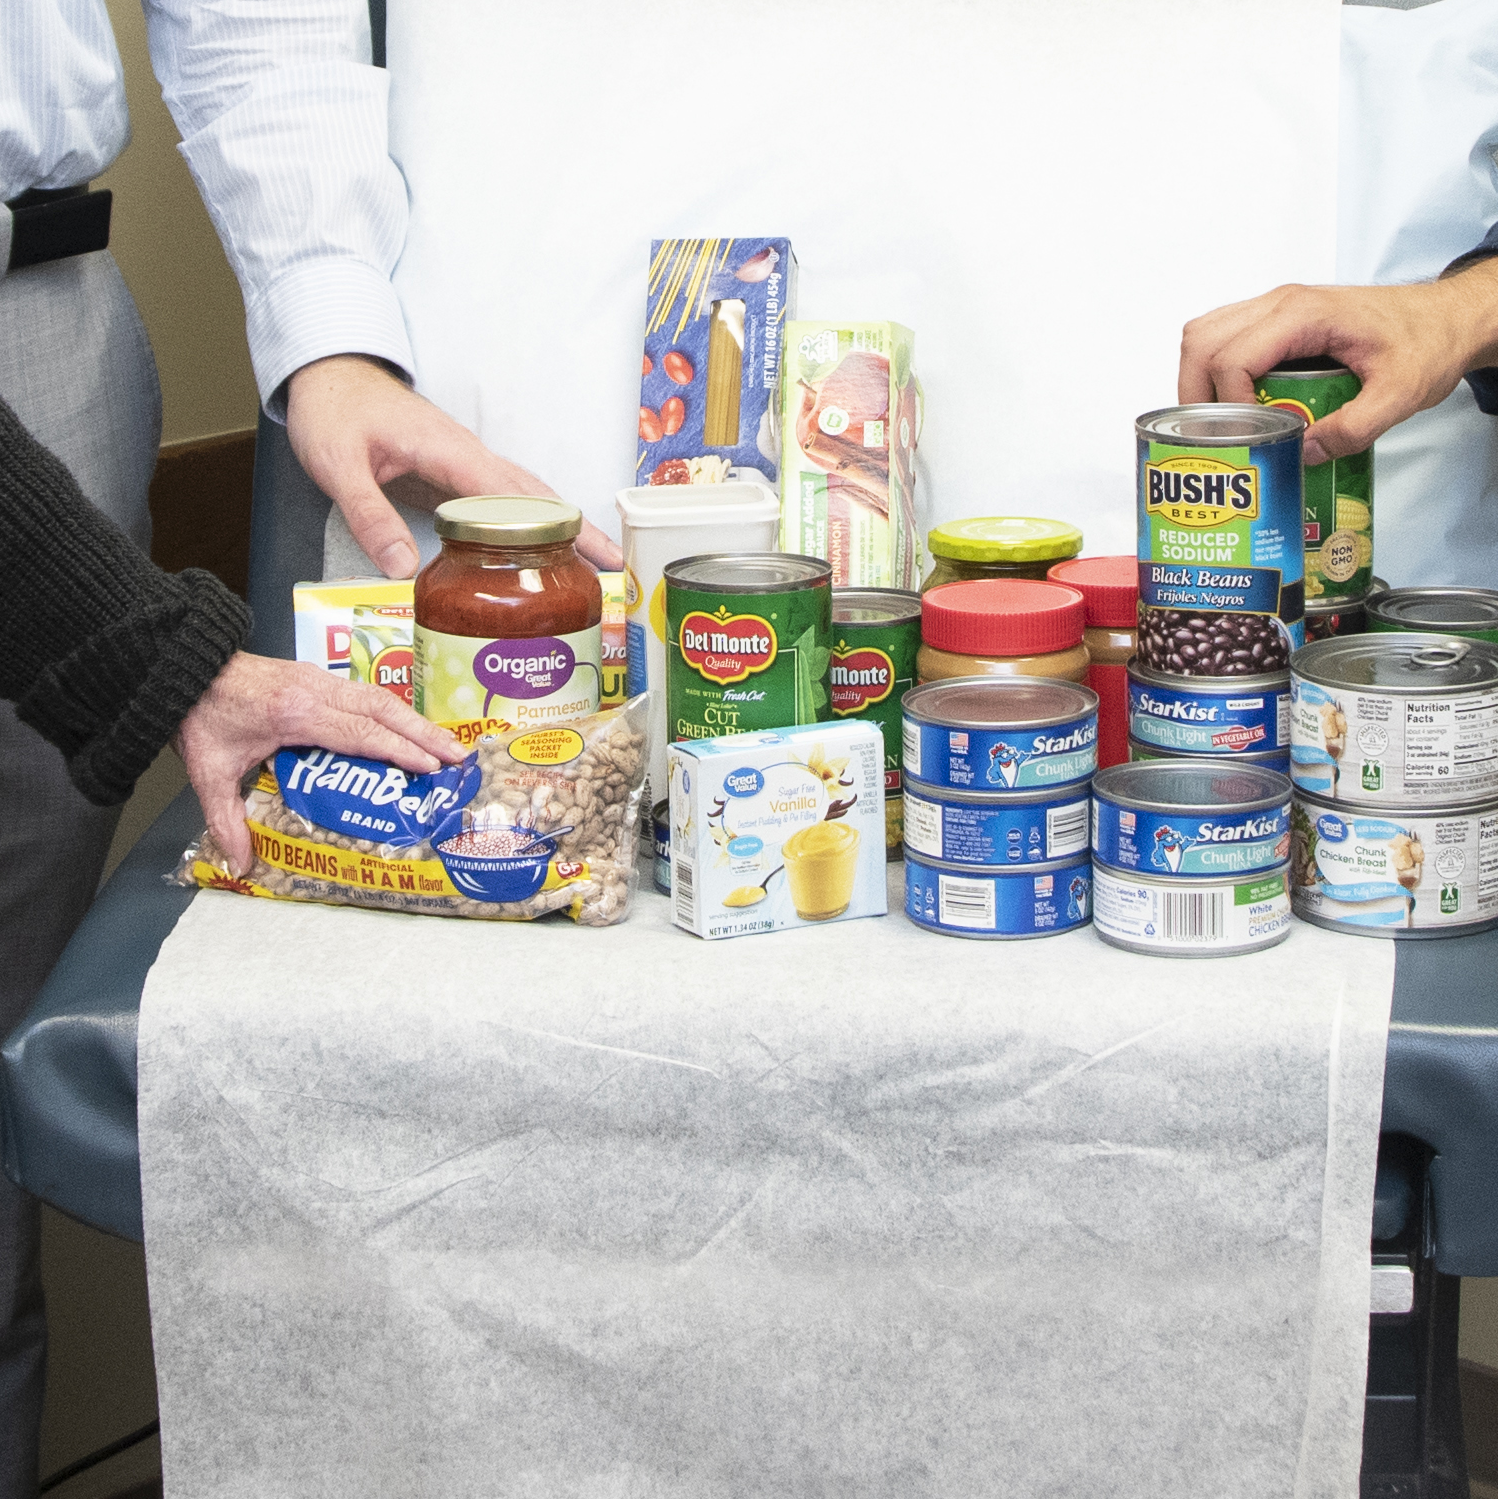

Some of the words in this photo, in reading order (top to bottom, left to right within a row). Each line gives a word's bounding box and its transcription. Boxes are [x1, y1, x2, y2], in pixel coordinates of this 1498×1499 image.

[768, 272, 782, 297] 454g
[764, 353, 776, 369] WT
[763, 369, 778, 389] NET
[1149, 468, 1252, 510] BUSH'S
[803, 480, 815, 525] Added
[1171, 508, 1220, 520] BEST
[804, 526, 817, 556] ugar
[1159, 529, 1241, 547] REDUCED
[831, 520, 842, 586] CINNAMON
[1331, 545, 1353, 556] NON
[1331, 555, 1353, 566] GMO
[1151, 566, 1193, 586] Black
[1196, 570, 1253, 588] Beans
[1156, 589, 1197, 604] Frijoles
[1199, 592, 1245, 607] Negros
[685, 629, 710, 650] Del
[711, 633, 770, 655] Monte
[484, 649, 567, 679] Organic
[705, 656, 742, 672] Quality
[378, 665, 409, 685] Del
[525, 673, 552, 685] Great
[832, 667, 889, 686] Monte
[517, 697, 590, 720] Parmesan
[1140, 693, 1220, 722] StarKist
[1407, 703, 1451, 713] Nutrition
[704, 708, 741, 726] CUT
[1407, 714, 1434, 723] Facts
[521, 737, 573, 746] SEASONING
[1142, 720, 1175, 738] Chunk
[1176, 726, 1207, 745] Light
[529, 744, 562, 752] PACKET
[1036, 761, 1074, 777] Chunk
[1437, 766, 1450, 775] 60
[728, 773, 758, 787] Great
[734, 784, 758, 793] Value
[769, 796, 817, 814] Vanilla
[340, 809, 397, 833] BRAND
[1196, 816, 1281, 843] StarKist
[252, 831, 280, 862] INTO
[284, 843, 338, 878] BEANS
[341, 864, 358, 882] with
[1201, 850, 1246, 865] Chunk
[1246, 845, 1272, 862] Light
[1320, 849, 1354, 864] Chicken
[1357, 856, 1387, 868] Breast
[1354, 845, 1387, 857] Chunk
[360, 857, 415, 873] ARTIFICIAL
[418, 874, 444, 892] flavor
[1248, 903, 1273, 915] White
[709, 927, 721, 936] NET
[722, 925, 732, 934] WT
